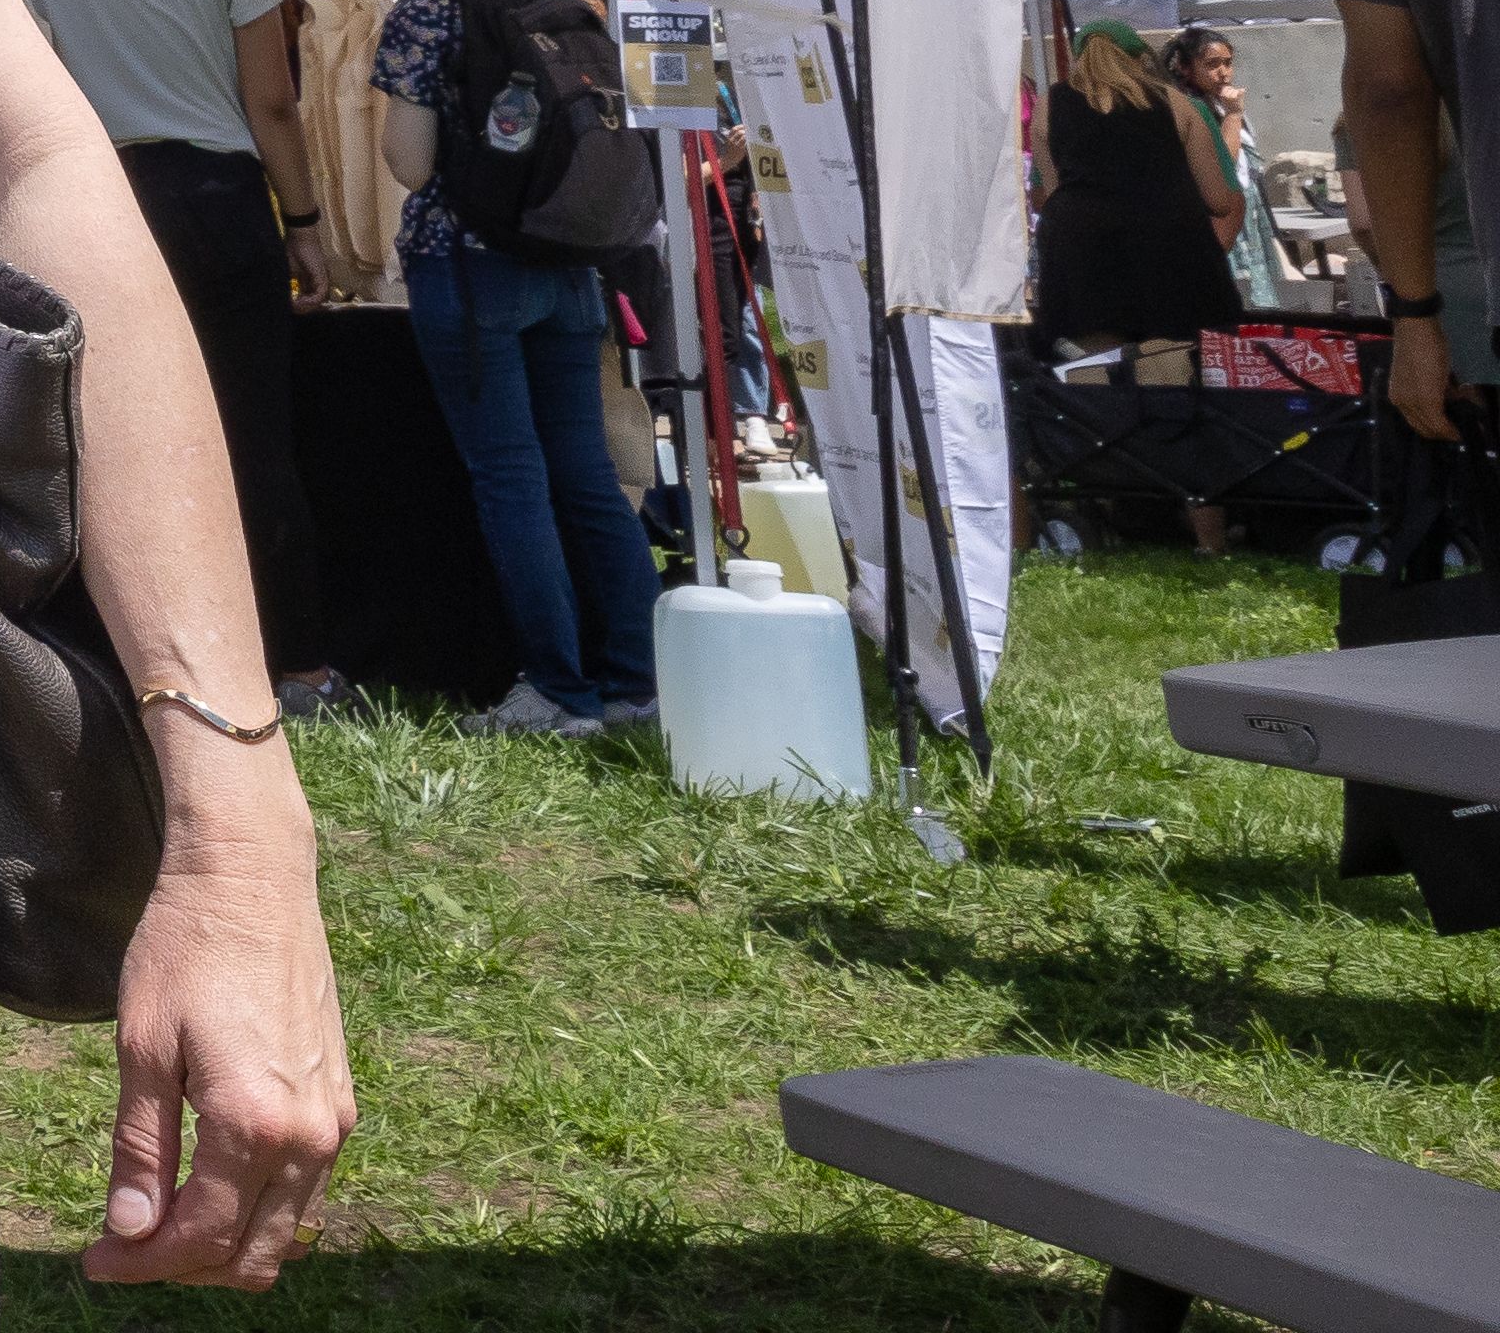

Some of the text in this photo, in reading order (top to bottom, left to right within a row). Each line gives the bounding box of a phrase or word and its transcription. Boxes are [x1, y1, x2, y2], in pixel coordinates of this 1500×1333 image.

[628, 16, 702, 30] SIGN UP
[644, 30, 688, 42] NOW
[1452, 803, 1491, 818] DENVER
